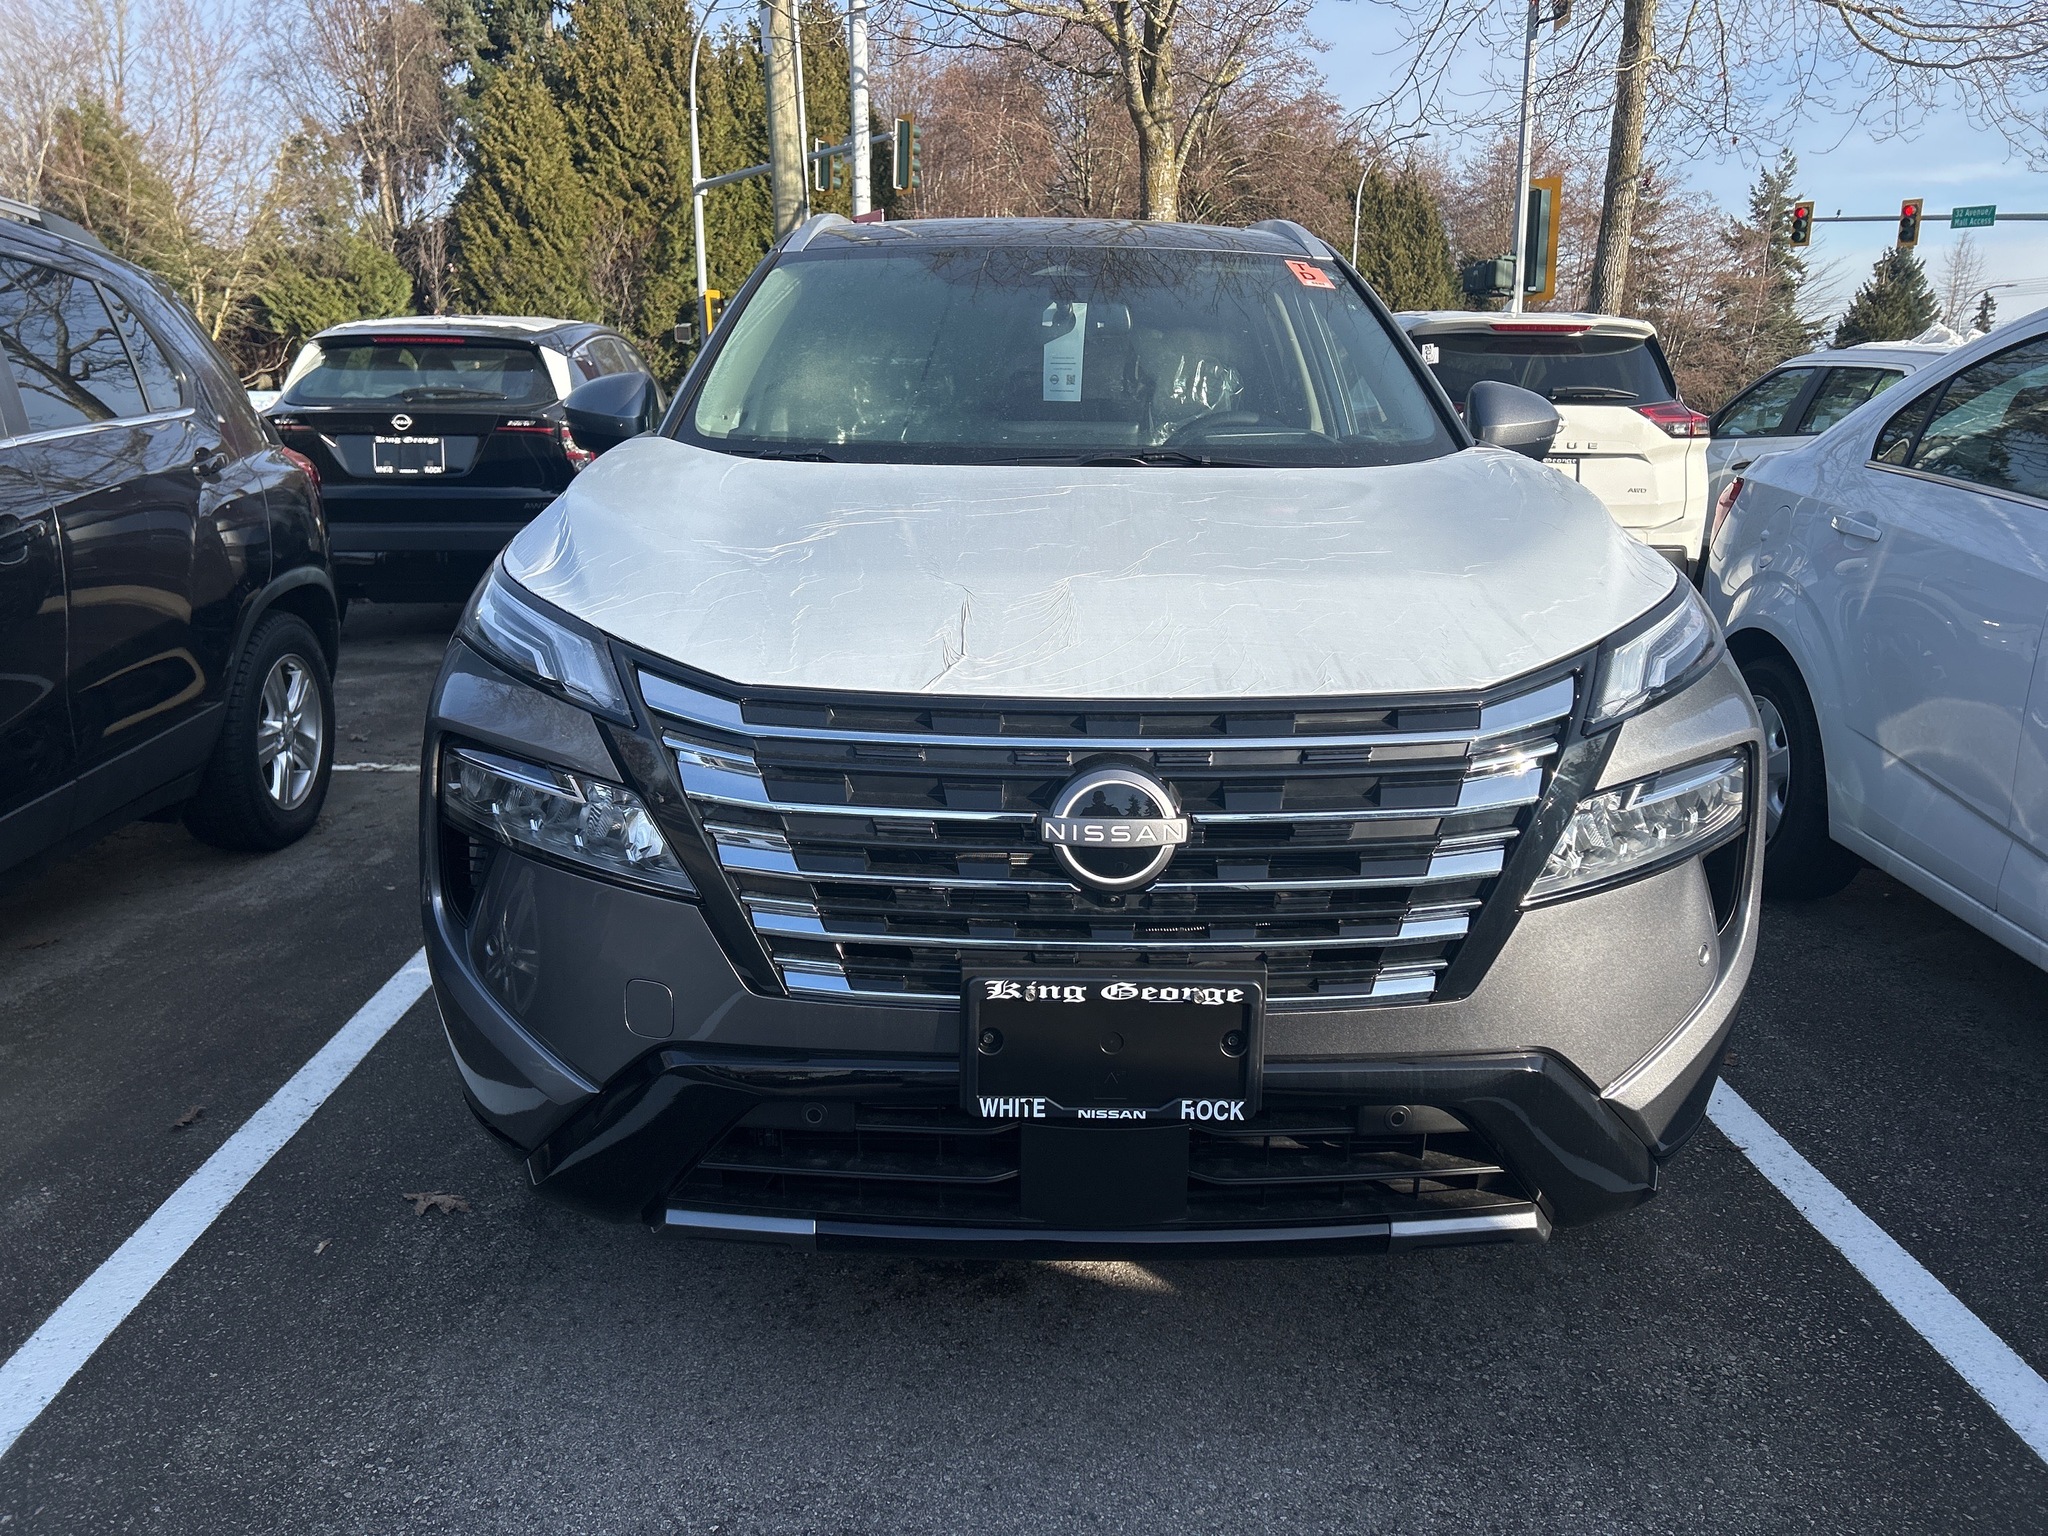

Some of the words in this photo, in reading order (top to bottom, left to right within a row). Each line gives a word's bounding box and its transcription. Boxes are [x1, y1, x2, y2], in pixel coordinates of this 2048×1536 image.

[1955, 209, 1964, 217] 32
[1969, 217, 1992, 225] Access
[1045, 822, 1185, 842] NISSAN
[1100, 981, 1245, 1006] George
[979, 1097, 1046, 1119] WHITE
[1077, 1109, 1147, 1120] NISSAN
[1181, 1100, 1245, 1121] ROCK
